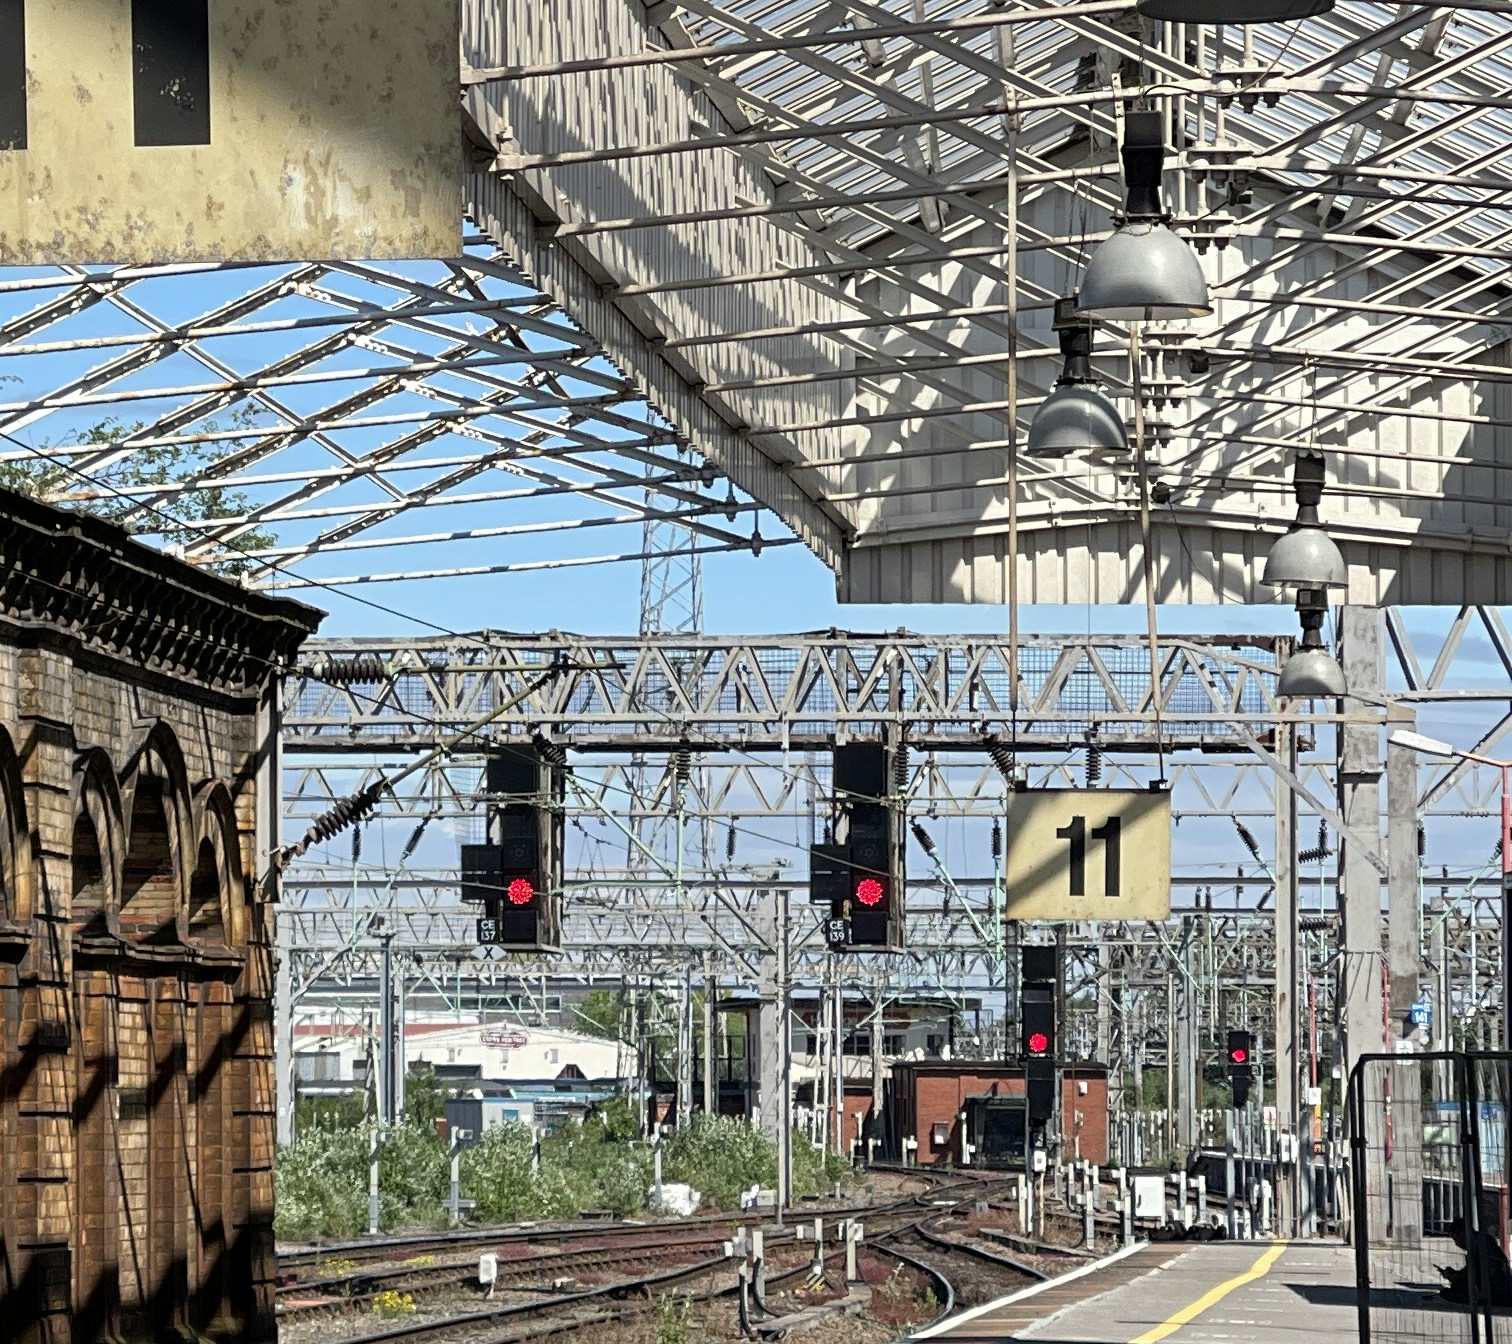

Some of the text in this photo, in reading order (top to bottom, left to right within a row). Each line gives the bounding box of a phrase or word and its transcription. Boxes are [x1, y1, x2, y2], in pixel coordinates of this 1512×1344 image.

[1056, 816, 1120, 896] 11
[481, 920, 495, 929] CE
[829, 920, 844, 929] CE
[481, 931, 496, 941] 137
[830, 932, 844, 942] 139
[483, 947, 494, 959] X
